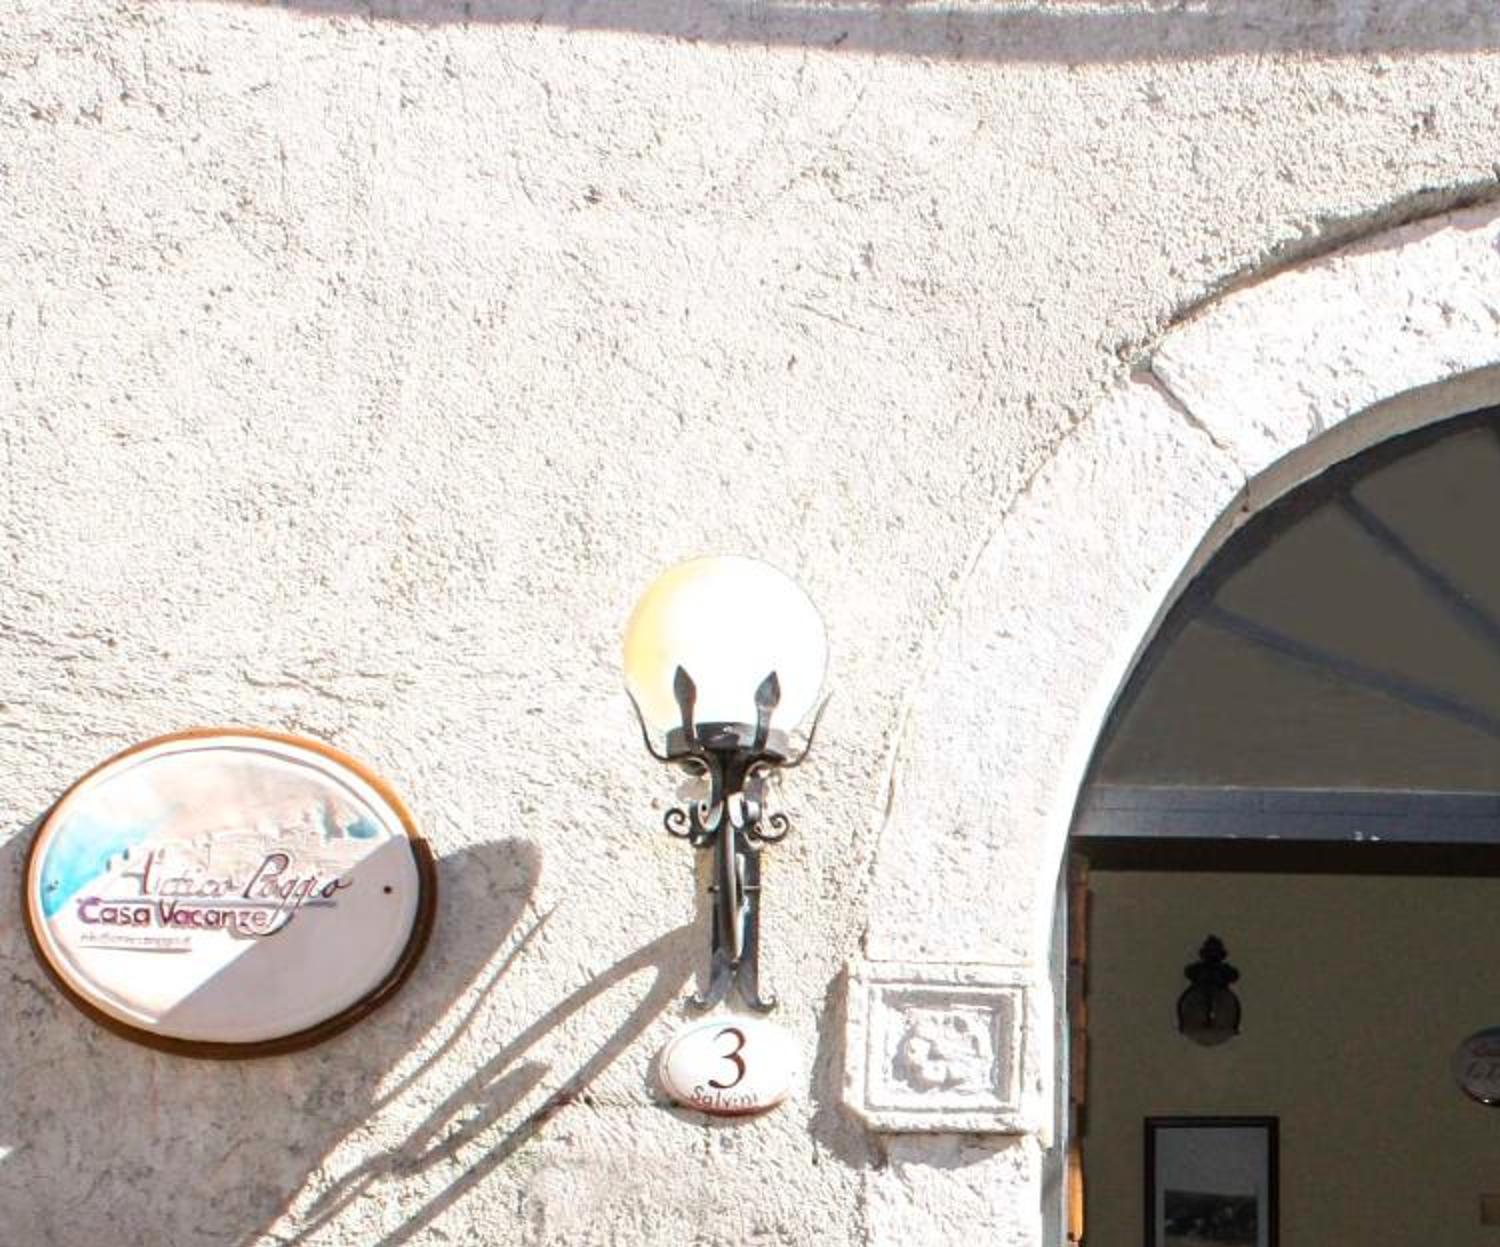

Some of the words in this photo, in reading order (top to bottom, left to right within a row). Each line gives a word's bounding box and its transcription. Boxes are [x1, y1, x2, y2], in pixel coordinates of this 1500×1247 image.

[76, 897, 152, 925] Casa
[159, 898, 269, 928] Vacanze
[243, 852, 353, 937] Poggio
[708, 1027, 746, 1089] 3
